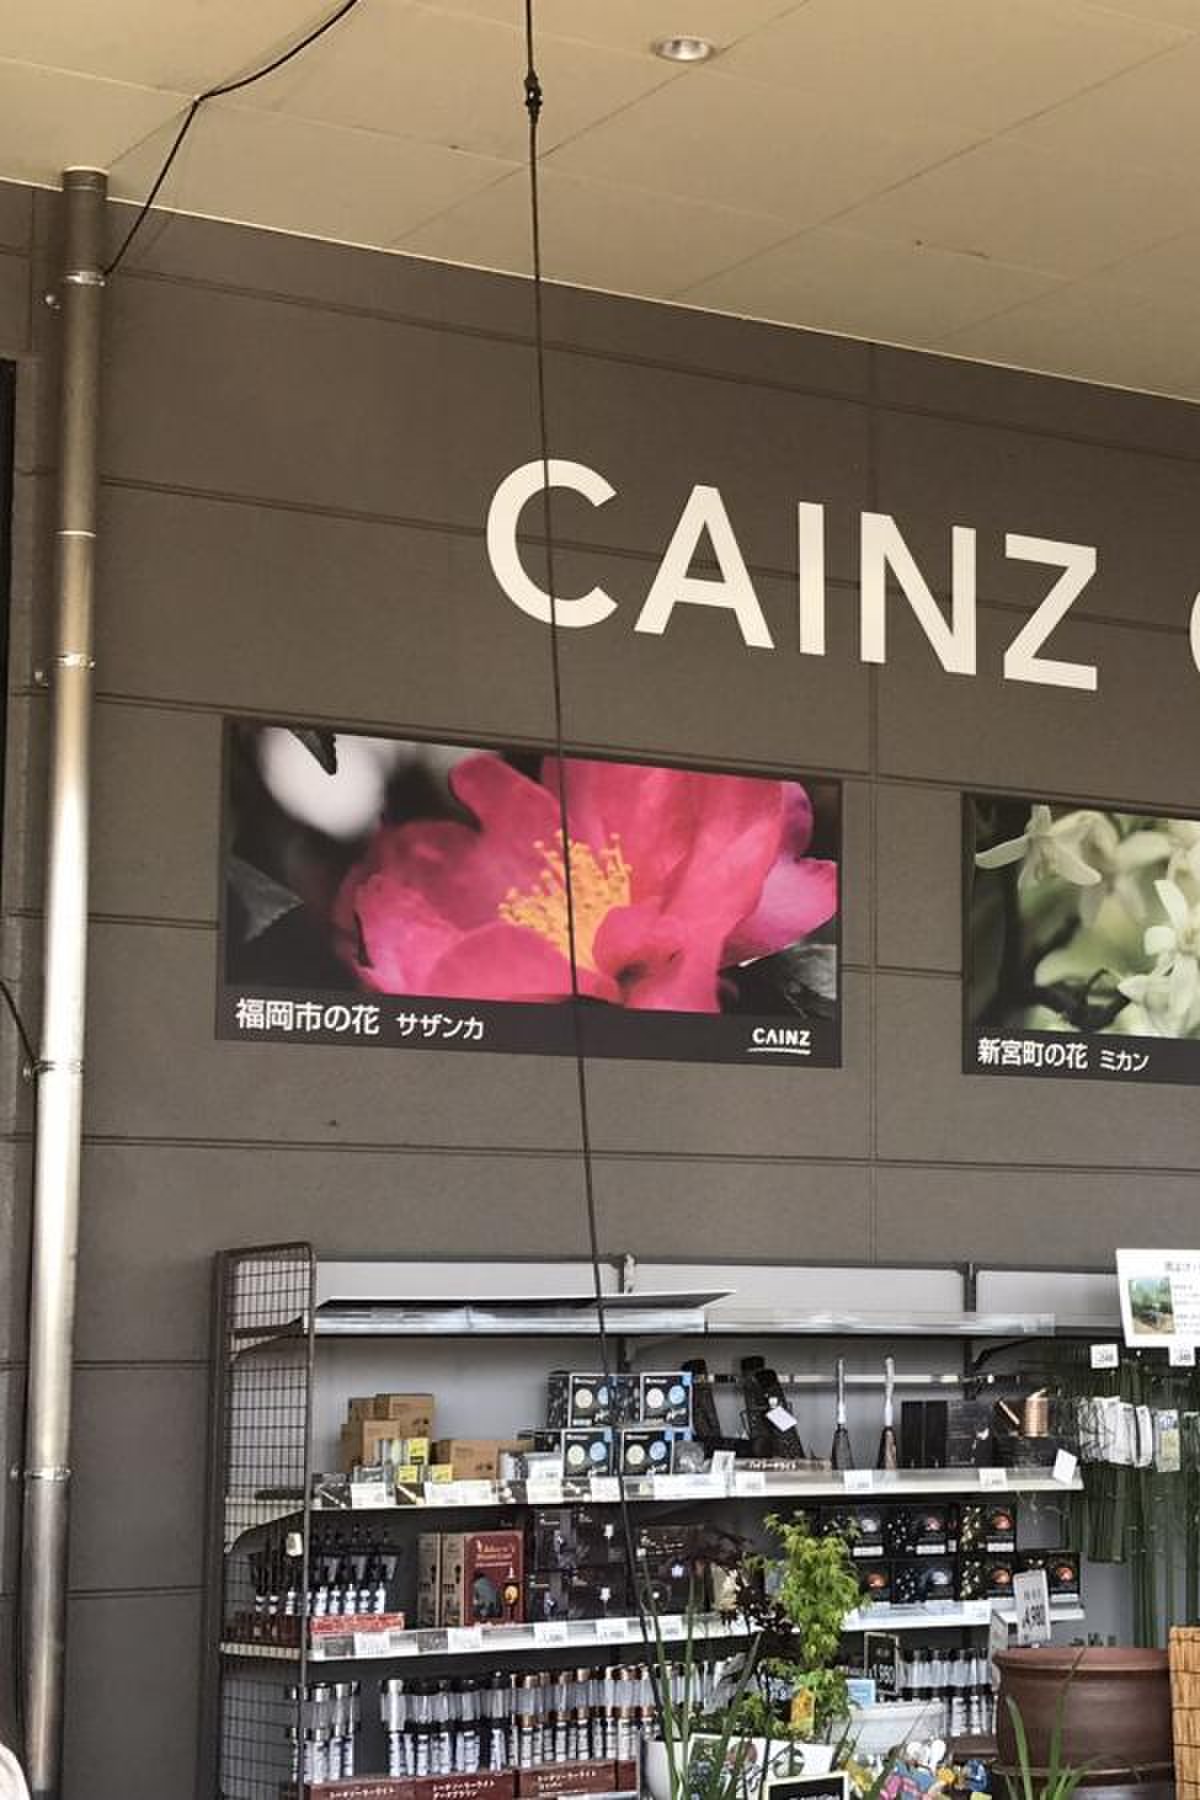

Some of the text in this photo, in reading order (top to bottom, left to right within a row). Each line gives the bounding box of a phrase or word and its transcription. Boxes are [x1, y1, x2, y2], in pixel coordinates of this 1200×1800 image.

[486, 459, 1098, 691] CAINZ
[235, 998, 484, 1040] 福岡市の花 サザンカ
[751, 1027, 811, 1047] CAINZ
[977, 1037, 1149, 1072] 新宮町の花 ミカン
